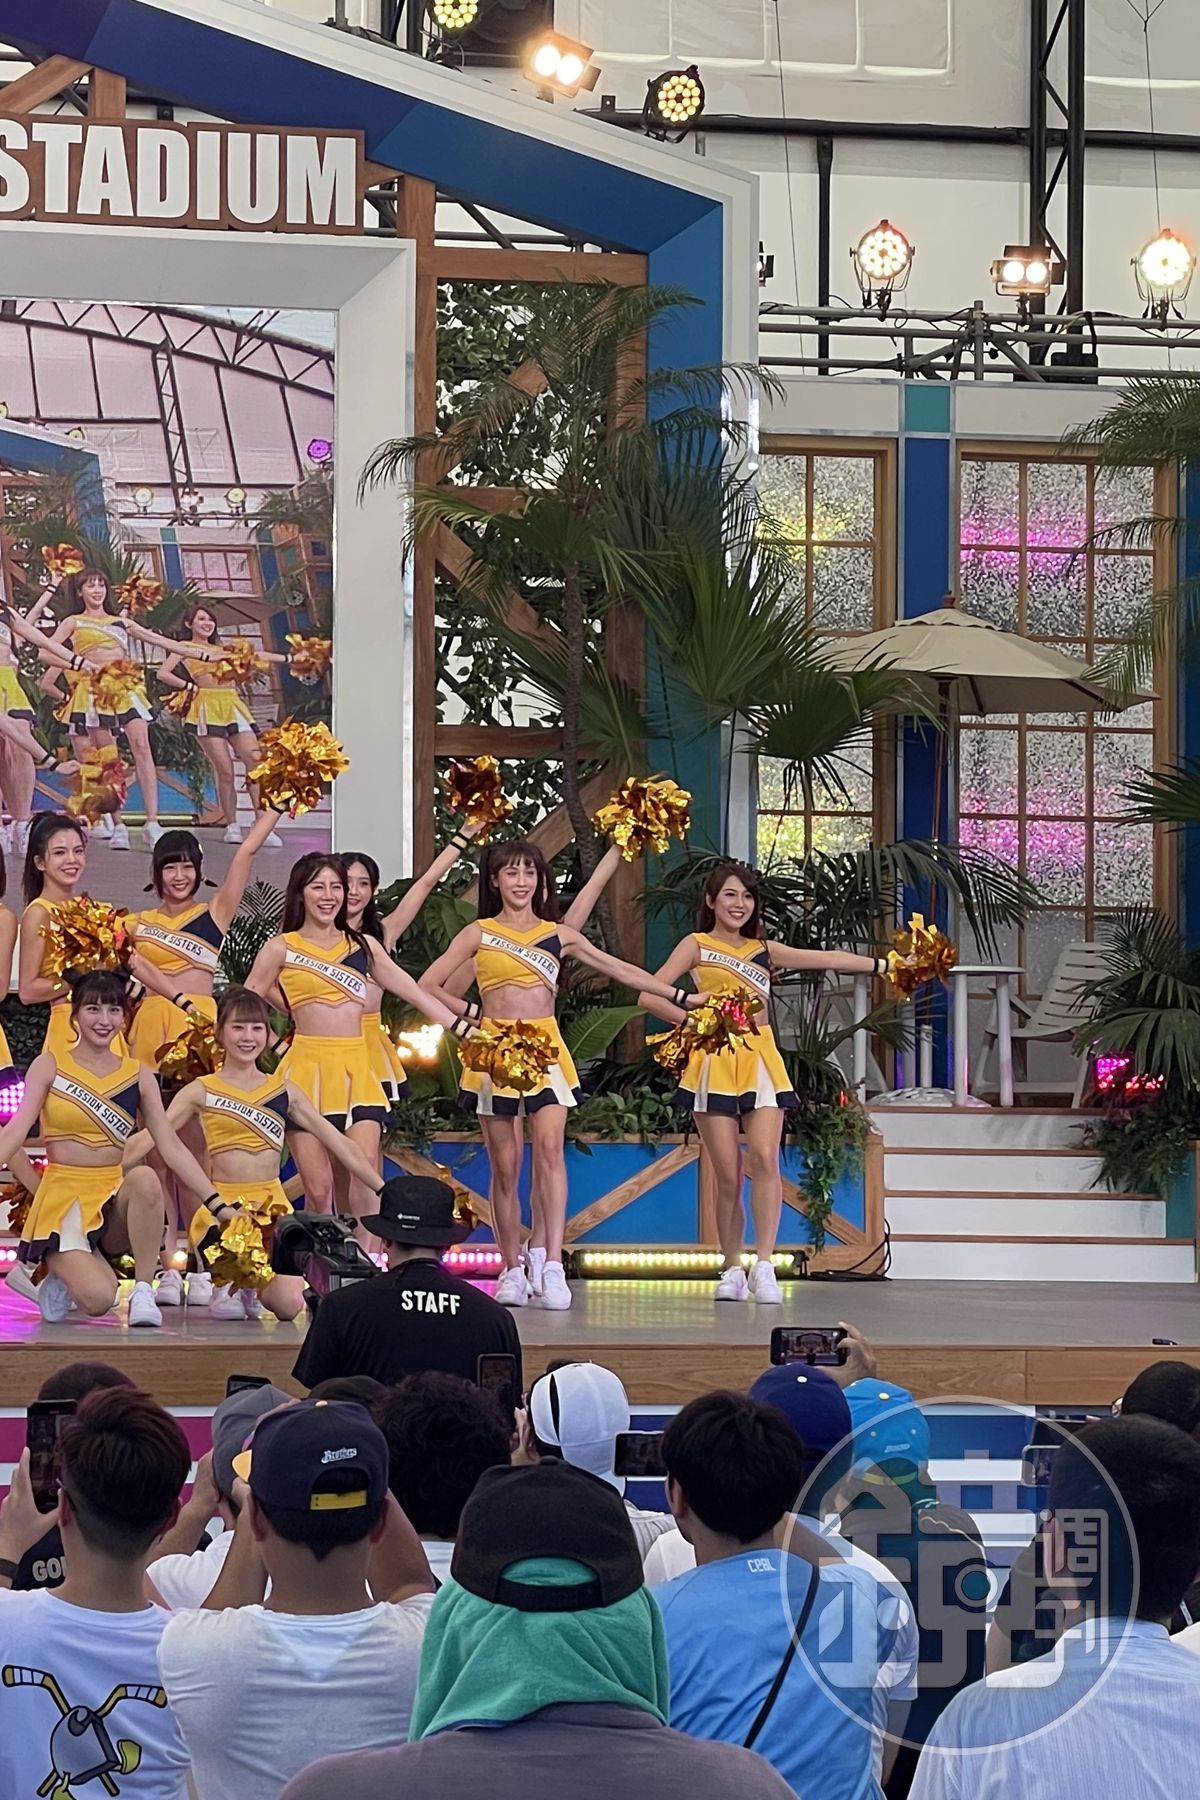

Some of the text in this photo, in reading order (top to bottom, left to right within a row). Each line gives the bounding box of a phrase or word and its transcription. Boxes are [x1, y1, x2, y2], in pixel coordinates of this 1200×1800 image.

[167, 935, 204, 956] SISTERS
[490, 937, 556, 975] PASSION SISTERS
[294, 954, 363, 993] PASSION SISTERS
[707, 952, 768, 987] PASSION SISTERS
[65, 1083, 131, 1137] PASSION SISTERS
[214, 1098, 283, 1139] PASSION SISTERS
[401, 1290, 461, 1315] STAFF
